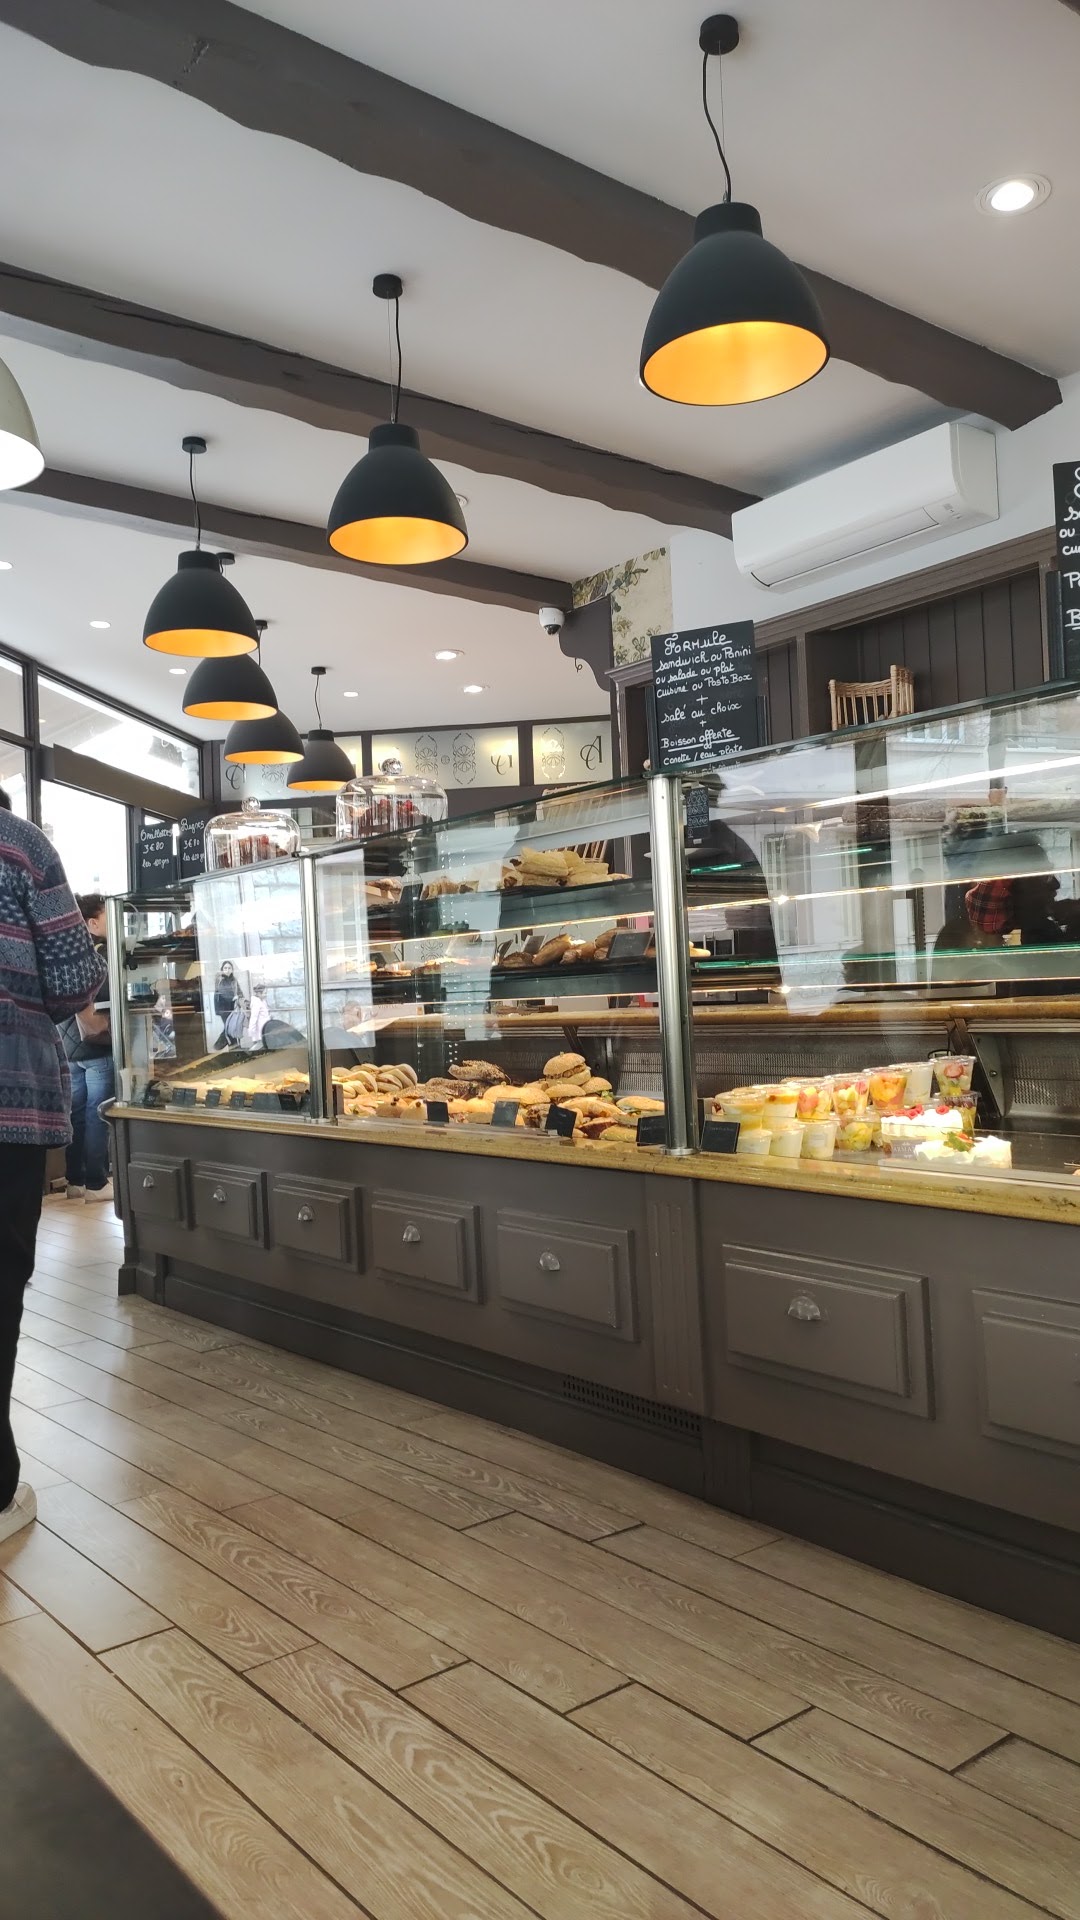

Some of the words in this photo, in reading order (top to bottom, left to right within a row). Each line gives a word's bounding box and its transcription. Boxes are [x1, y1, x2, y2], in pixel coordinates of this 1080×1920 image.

[1059, 528, 1075, 538] ou
[656, 650, 710, 672] sandwich
[711, 653, 722, 662] ou
[722, 645, 752, 659] Panini
[656, 676, 666, 684] ou
[667, 668, 698, 683] salade
[700, 667, 711, 675] ou
[713, 662, 735, 676] plat
[692, 681, 703, 691] ou
[730, 674, 752, 684] Box
[661, 704, 686, 723] salé
[691, 710, 705, 719] au
[710, 700, 742, 715] choix
[660, 734, 696, 749] Boisson
[700, 750, 717, 759] eau
